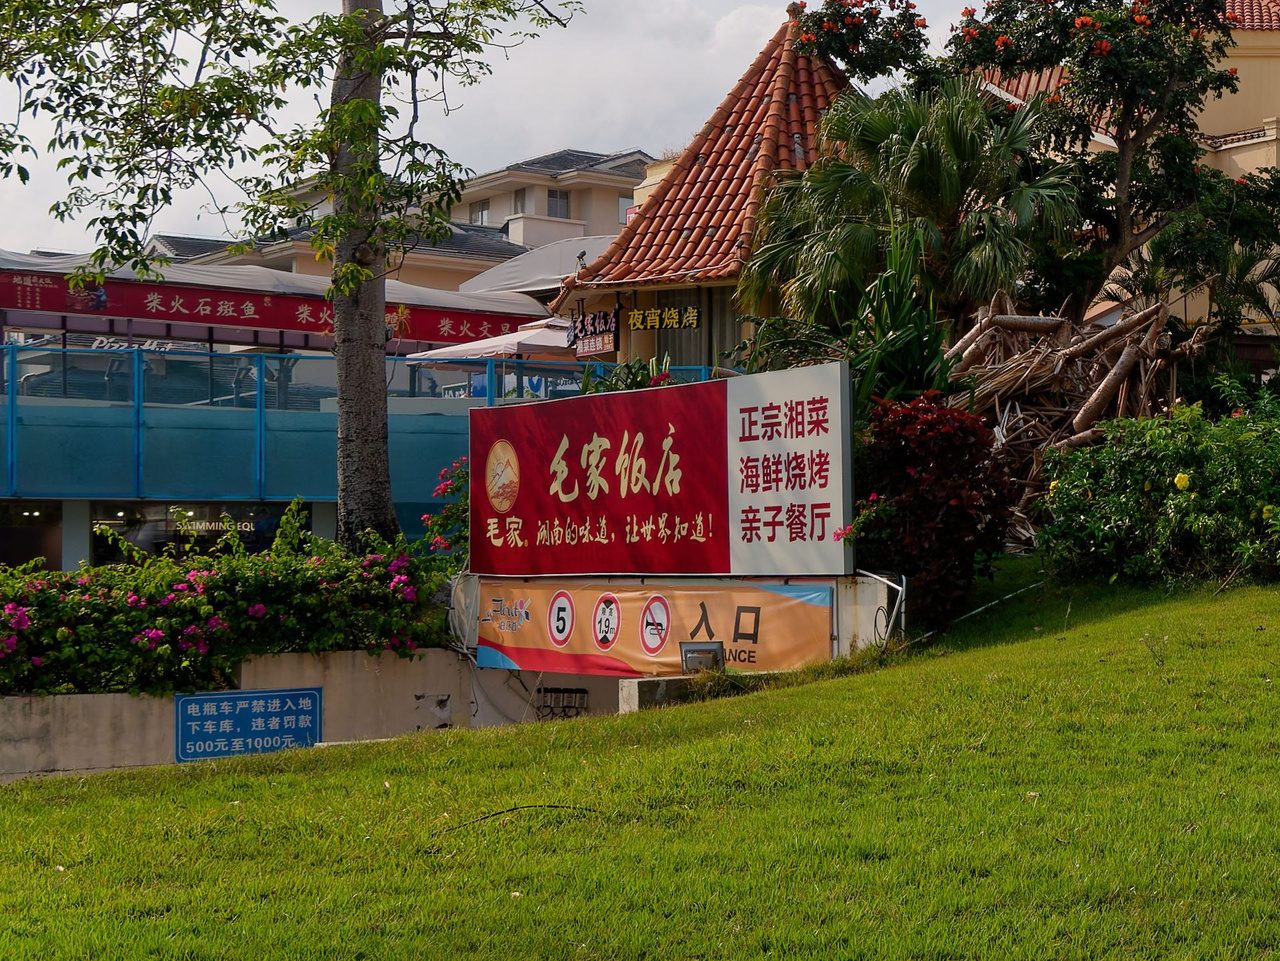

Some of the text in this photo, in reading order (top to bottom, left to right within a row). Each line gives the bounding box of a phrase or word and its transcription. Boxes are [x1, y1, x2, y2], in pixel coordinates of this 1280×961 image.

[144, 292, 260, 319] 柴火石斑鱼
[628, 306, 699, 331] 夜宵烧烤
[574, 311, 616, 337] 毛家饭店
[739, 396, 829, 442] 正宗湘菜
[549, 422, 683, 503] 毛家饭店
[739, 449, 830, 493] 海鲜烧烤
[486, 516, 525, 547] 毛家
[740, 503, 831, 543] 亲子餐厅
[555, 607, 566, 634] 5
[690, 601, 761, 644] 入口
[187, 698, 312, 716] 电瓶车严禁进入地
[186, 734, 295, 753] 500元至1000元
